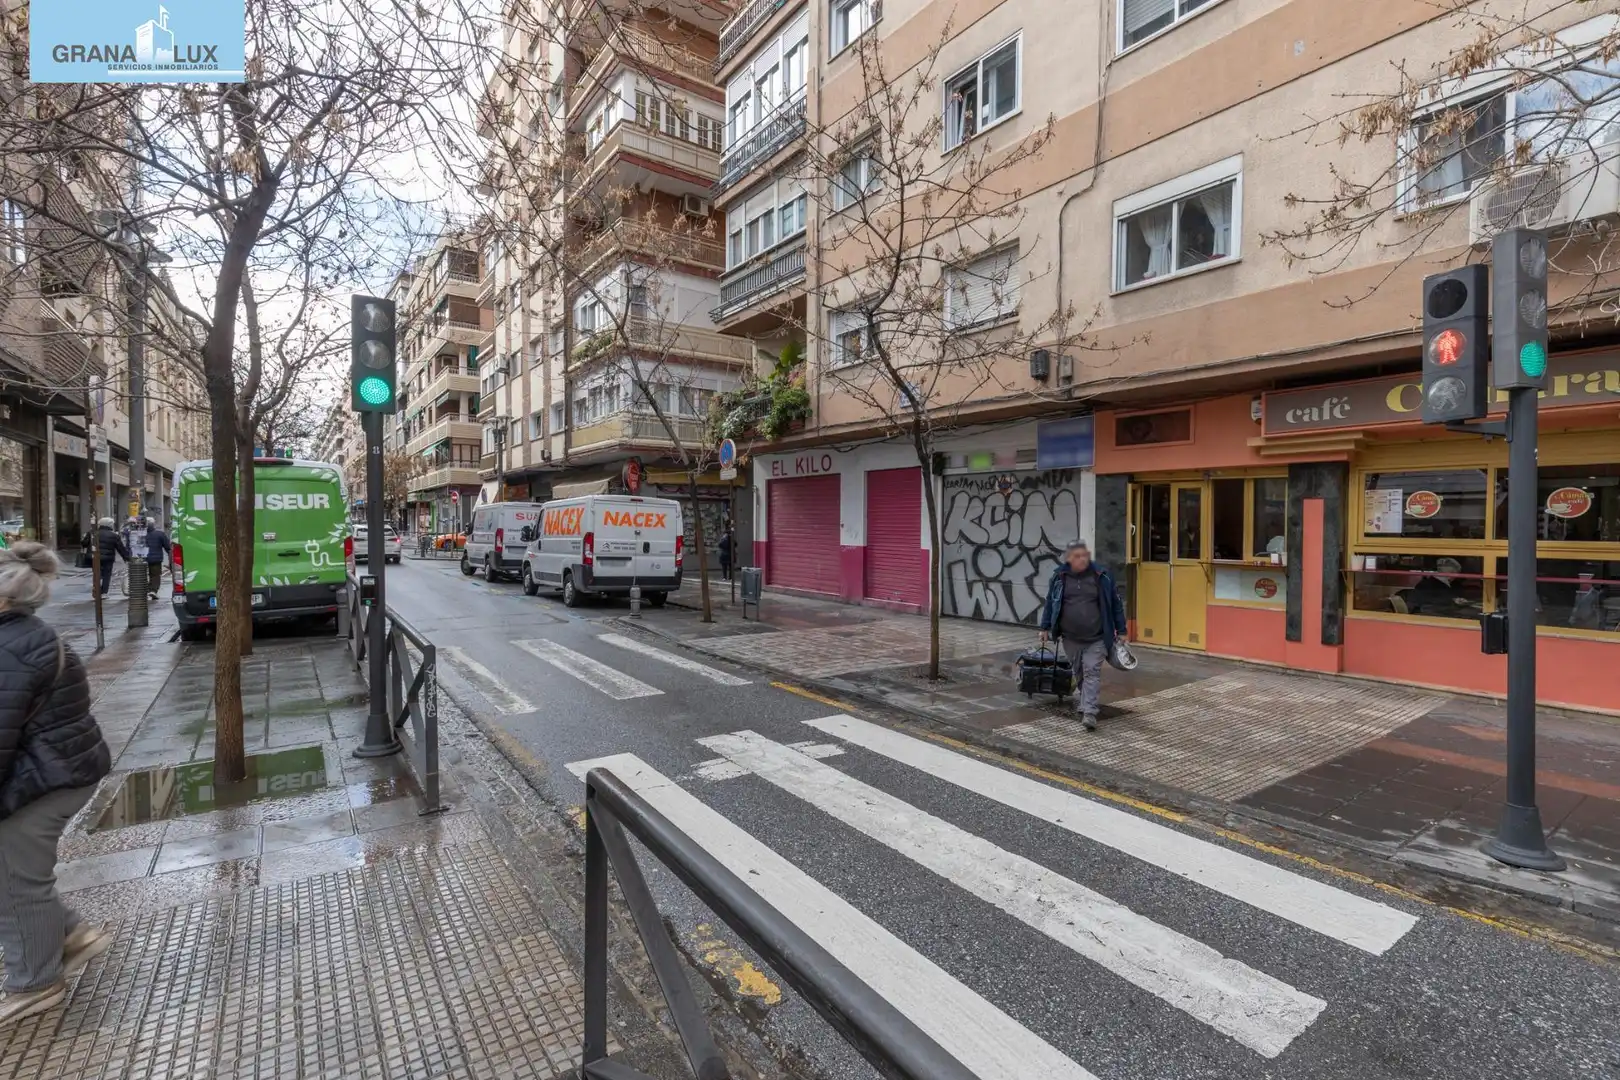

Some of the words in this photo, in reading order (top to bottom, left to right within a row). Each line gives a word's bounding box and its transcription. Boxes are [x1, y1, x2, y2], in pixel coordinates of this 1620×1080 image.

[1285, 396, 1351, 424] café
[772, 460, 788, 477] EL
[795, 454, 832, 475] KILO
[266, 493, 330, 510] SEUR
[543, 507, 585, 536] NACEX
[603, 510, 667, 529] NACEX
